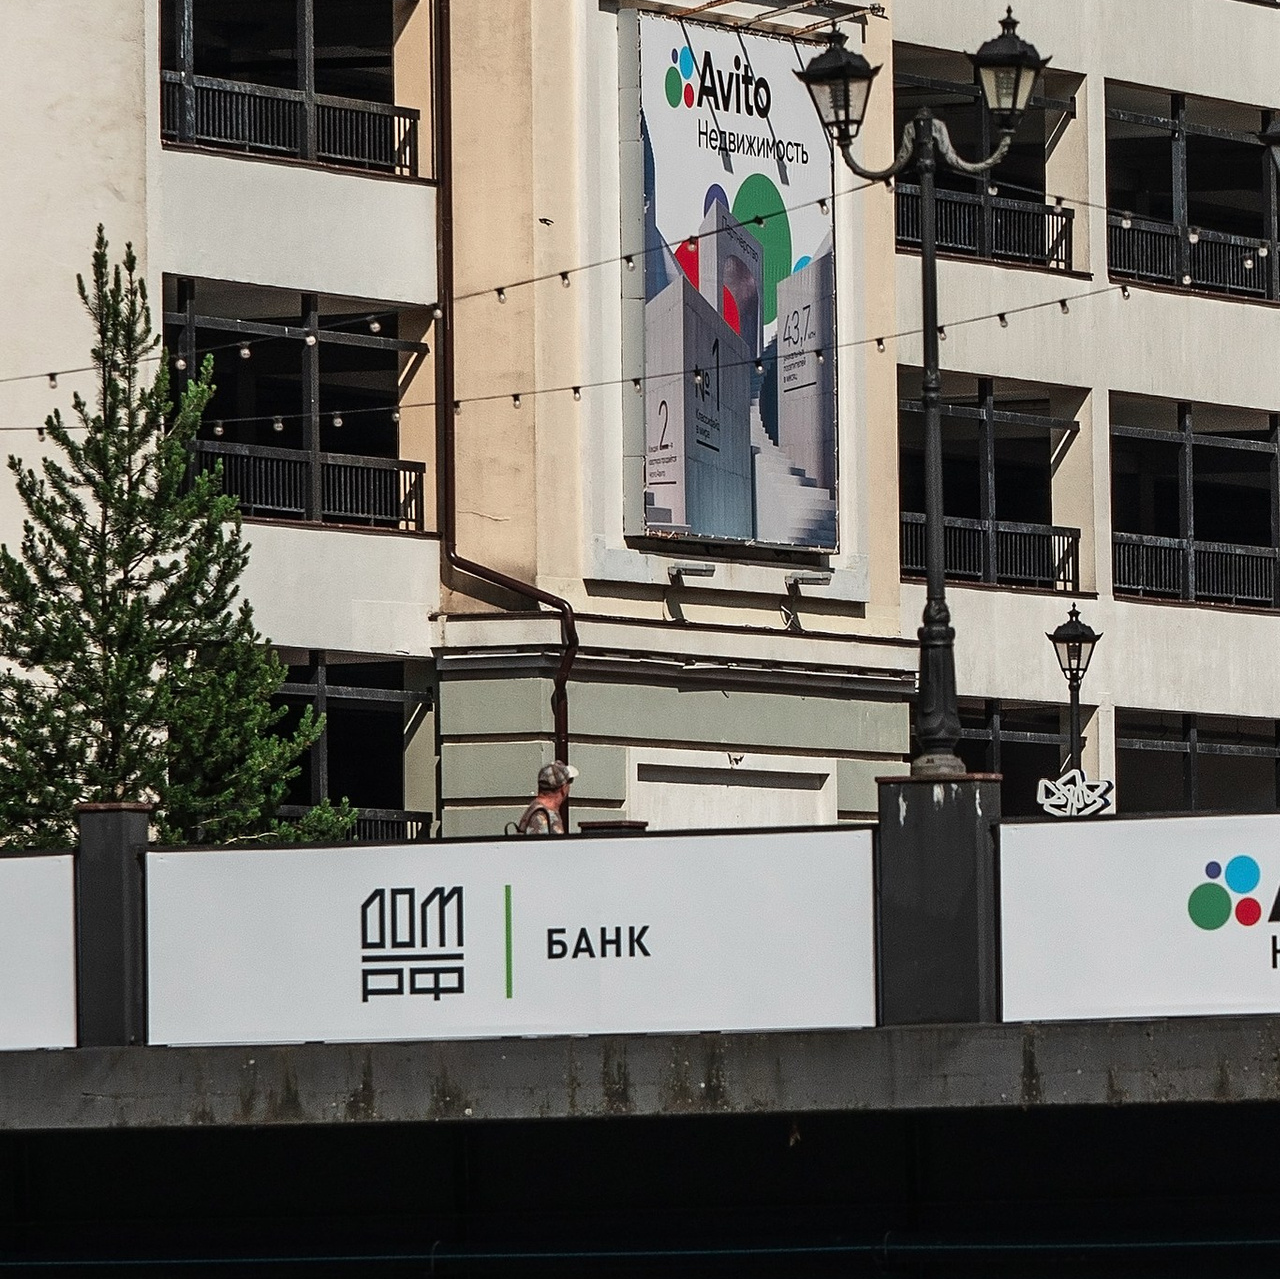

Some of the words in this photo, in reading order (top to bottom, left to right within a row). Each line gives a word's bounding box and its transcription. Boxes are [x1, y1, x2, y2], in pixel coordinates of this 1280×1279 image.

[697, 51, 771, 118] Avito
[698, 119, 809, 164] Недвижимость
[783, 305, 811, 348] 43,7
[361, 886, 464, 949] ДОМ
[547, 925, 651, 960] БАНК
[361, 966, 465, 1003] РФ
